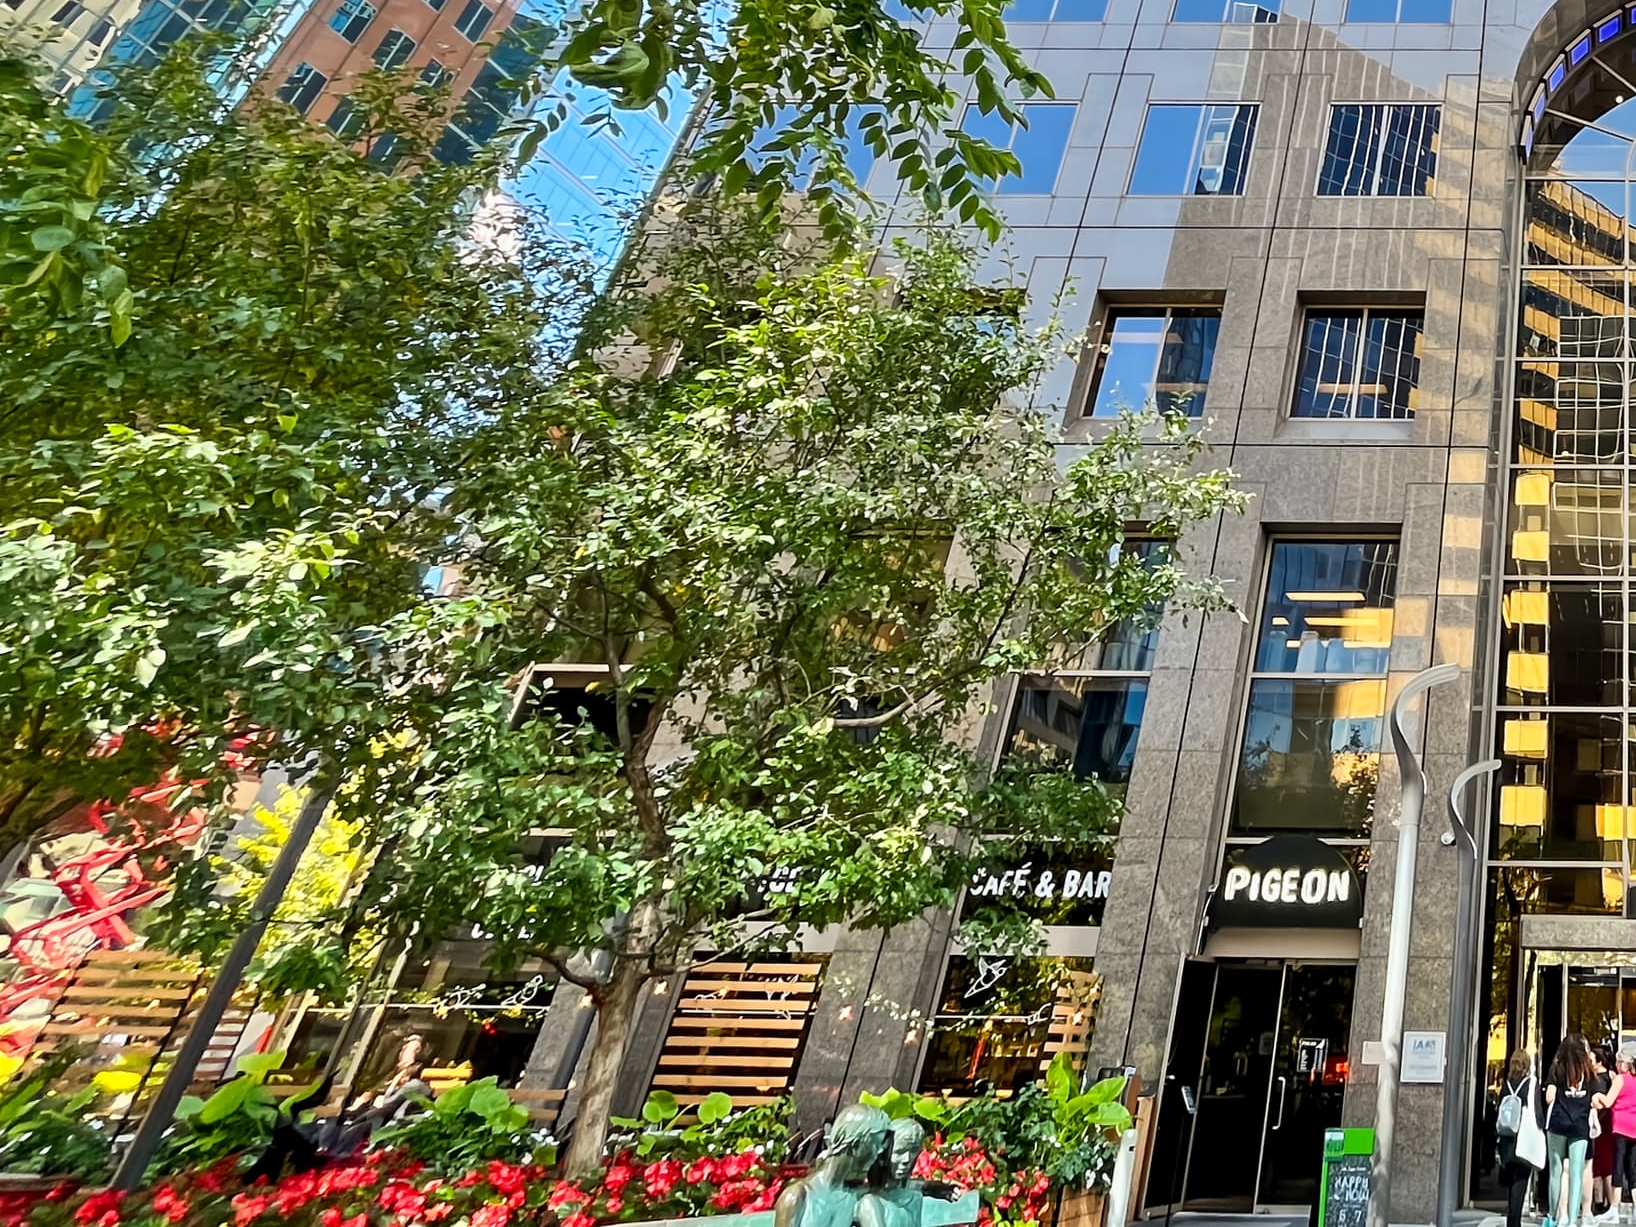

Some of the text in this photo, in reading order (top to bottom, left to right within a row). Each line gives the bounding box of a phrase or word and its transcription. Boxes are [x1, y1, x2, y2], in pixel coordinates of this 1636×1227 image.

[1034, 870, 1056, 898] &
[1062, 869, 1113, 898] BAR
[1224, 865, 1350, 904] PIGEON
